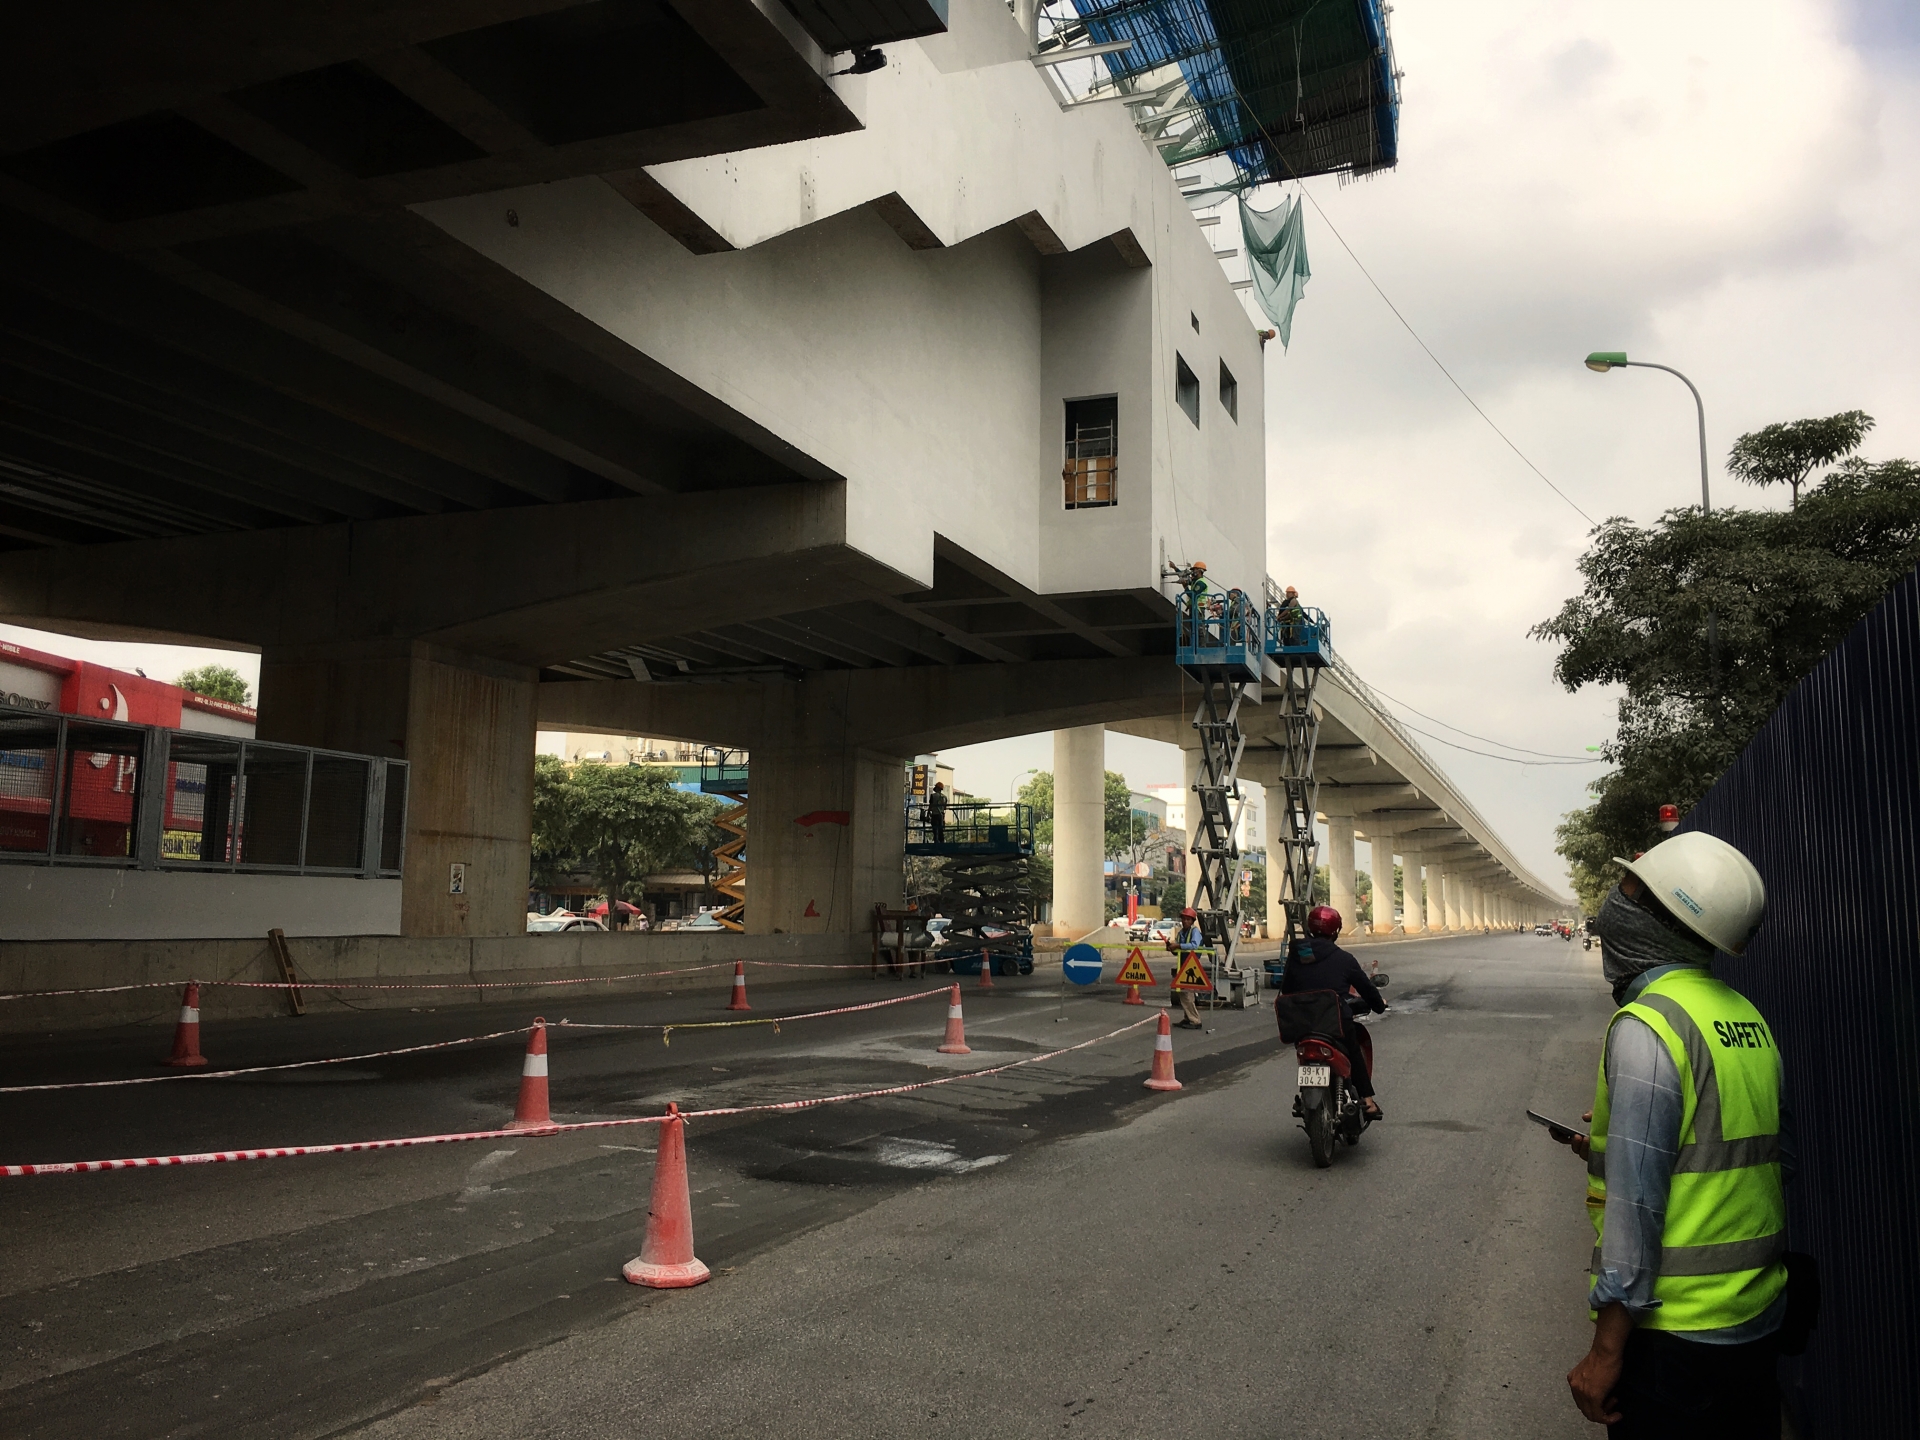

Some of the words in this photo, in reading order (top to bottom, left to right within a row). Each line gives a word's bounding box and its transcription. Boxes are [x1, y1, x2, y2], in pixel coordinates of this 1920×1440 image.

[1132, 962, 1140, 970] ĐI
[1125, 971, 1146, 981] CHẬM
[1713, 1020, 1770, 1048] SAFETY
[1302, 1067, 1325, 1076] 99-K1
[1299, 1076, 1327, 1085] 304.21
